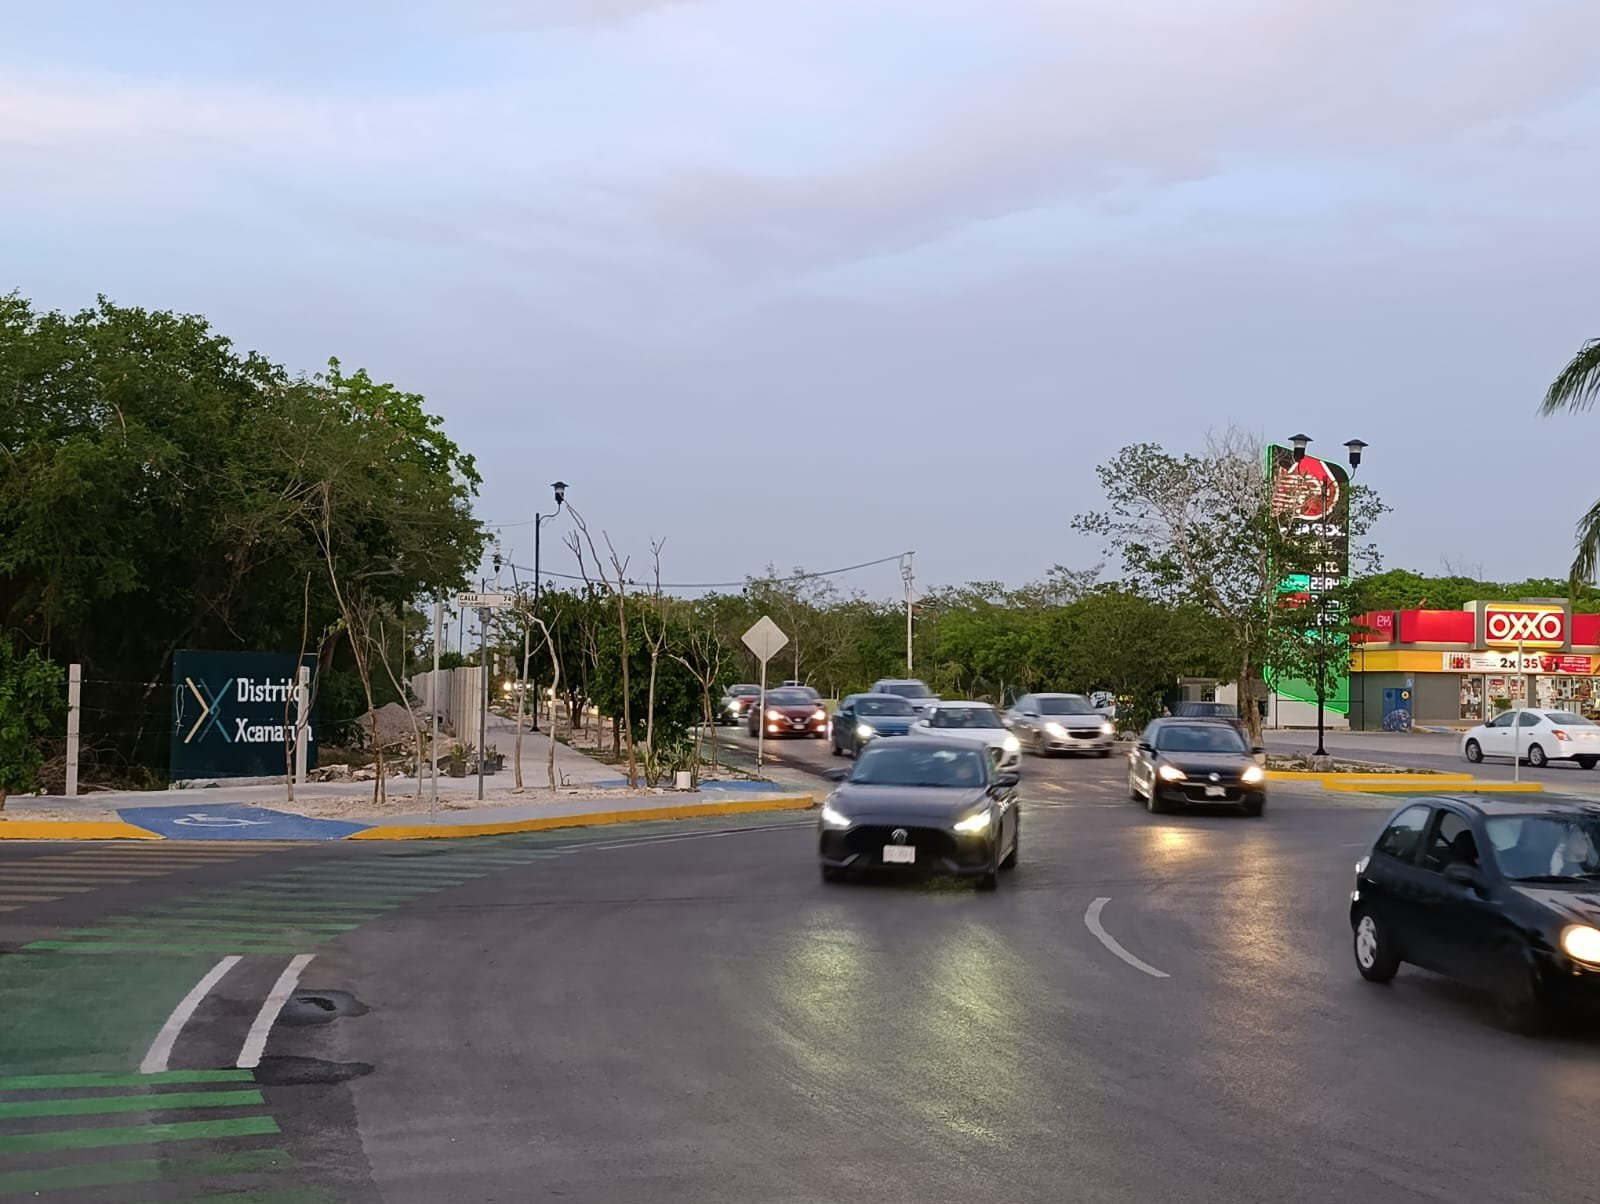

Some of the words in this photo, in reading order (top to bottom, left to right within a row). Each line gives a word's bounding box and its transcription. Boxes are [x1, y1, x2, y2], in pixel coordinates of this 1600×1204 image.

[1489, 613, 1561, 640] OXXO
[1523, 658, 1538, 668] 35
[237, 677, 302, 702] Distrito
[234, 718, 313, 743] Xcanan
